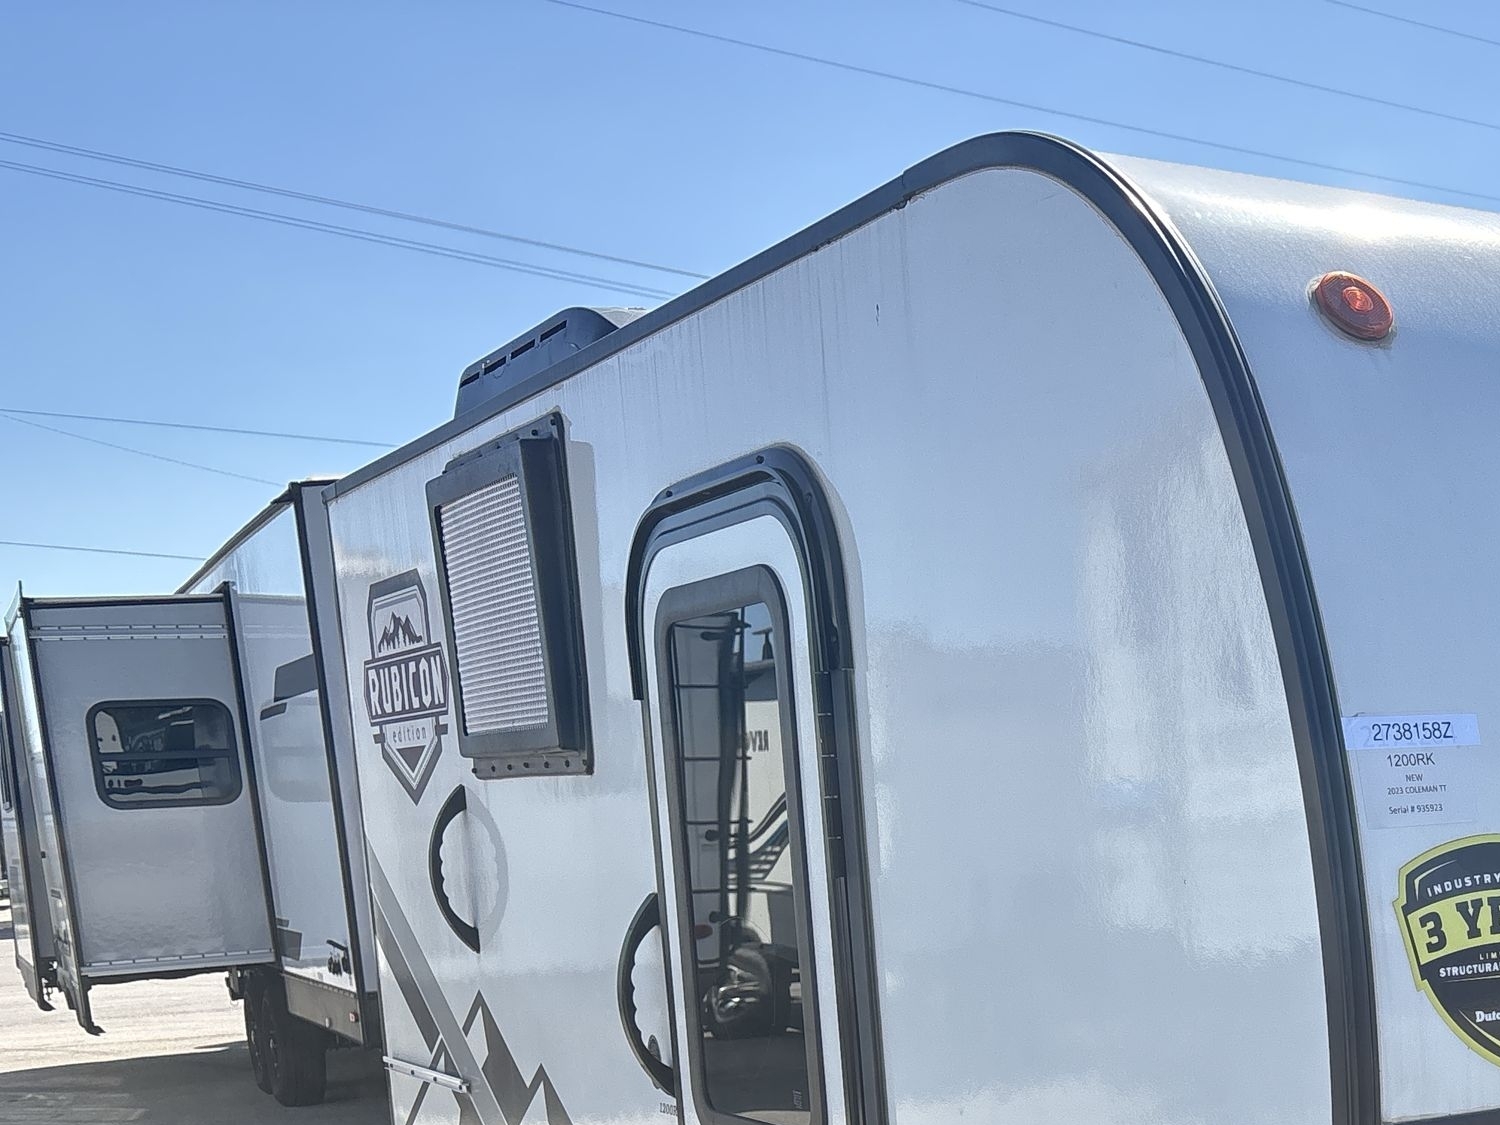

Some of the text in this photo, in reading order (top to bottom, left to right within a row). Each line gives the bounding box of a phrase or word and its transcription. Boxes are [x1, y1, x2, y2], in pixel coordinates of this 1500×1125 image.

[368, 655, 444, 716] RUBICON
[392, 725, 427, 744] edition
[1371, 722, 1453, 741] 2738158Z
[1386, 752, 1435, 767] 1200RK
[1405, 774, 1423, 782] NEW
[1387, 784, 1447, 795] 2023 COLEMAN TT
[1388, 805, 1409, 815] Serial
[1418, 911, 1447, 954] 3
